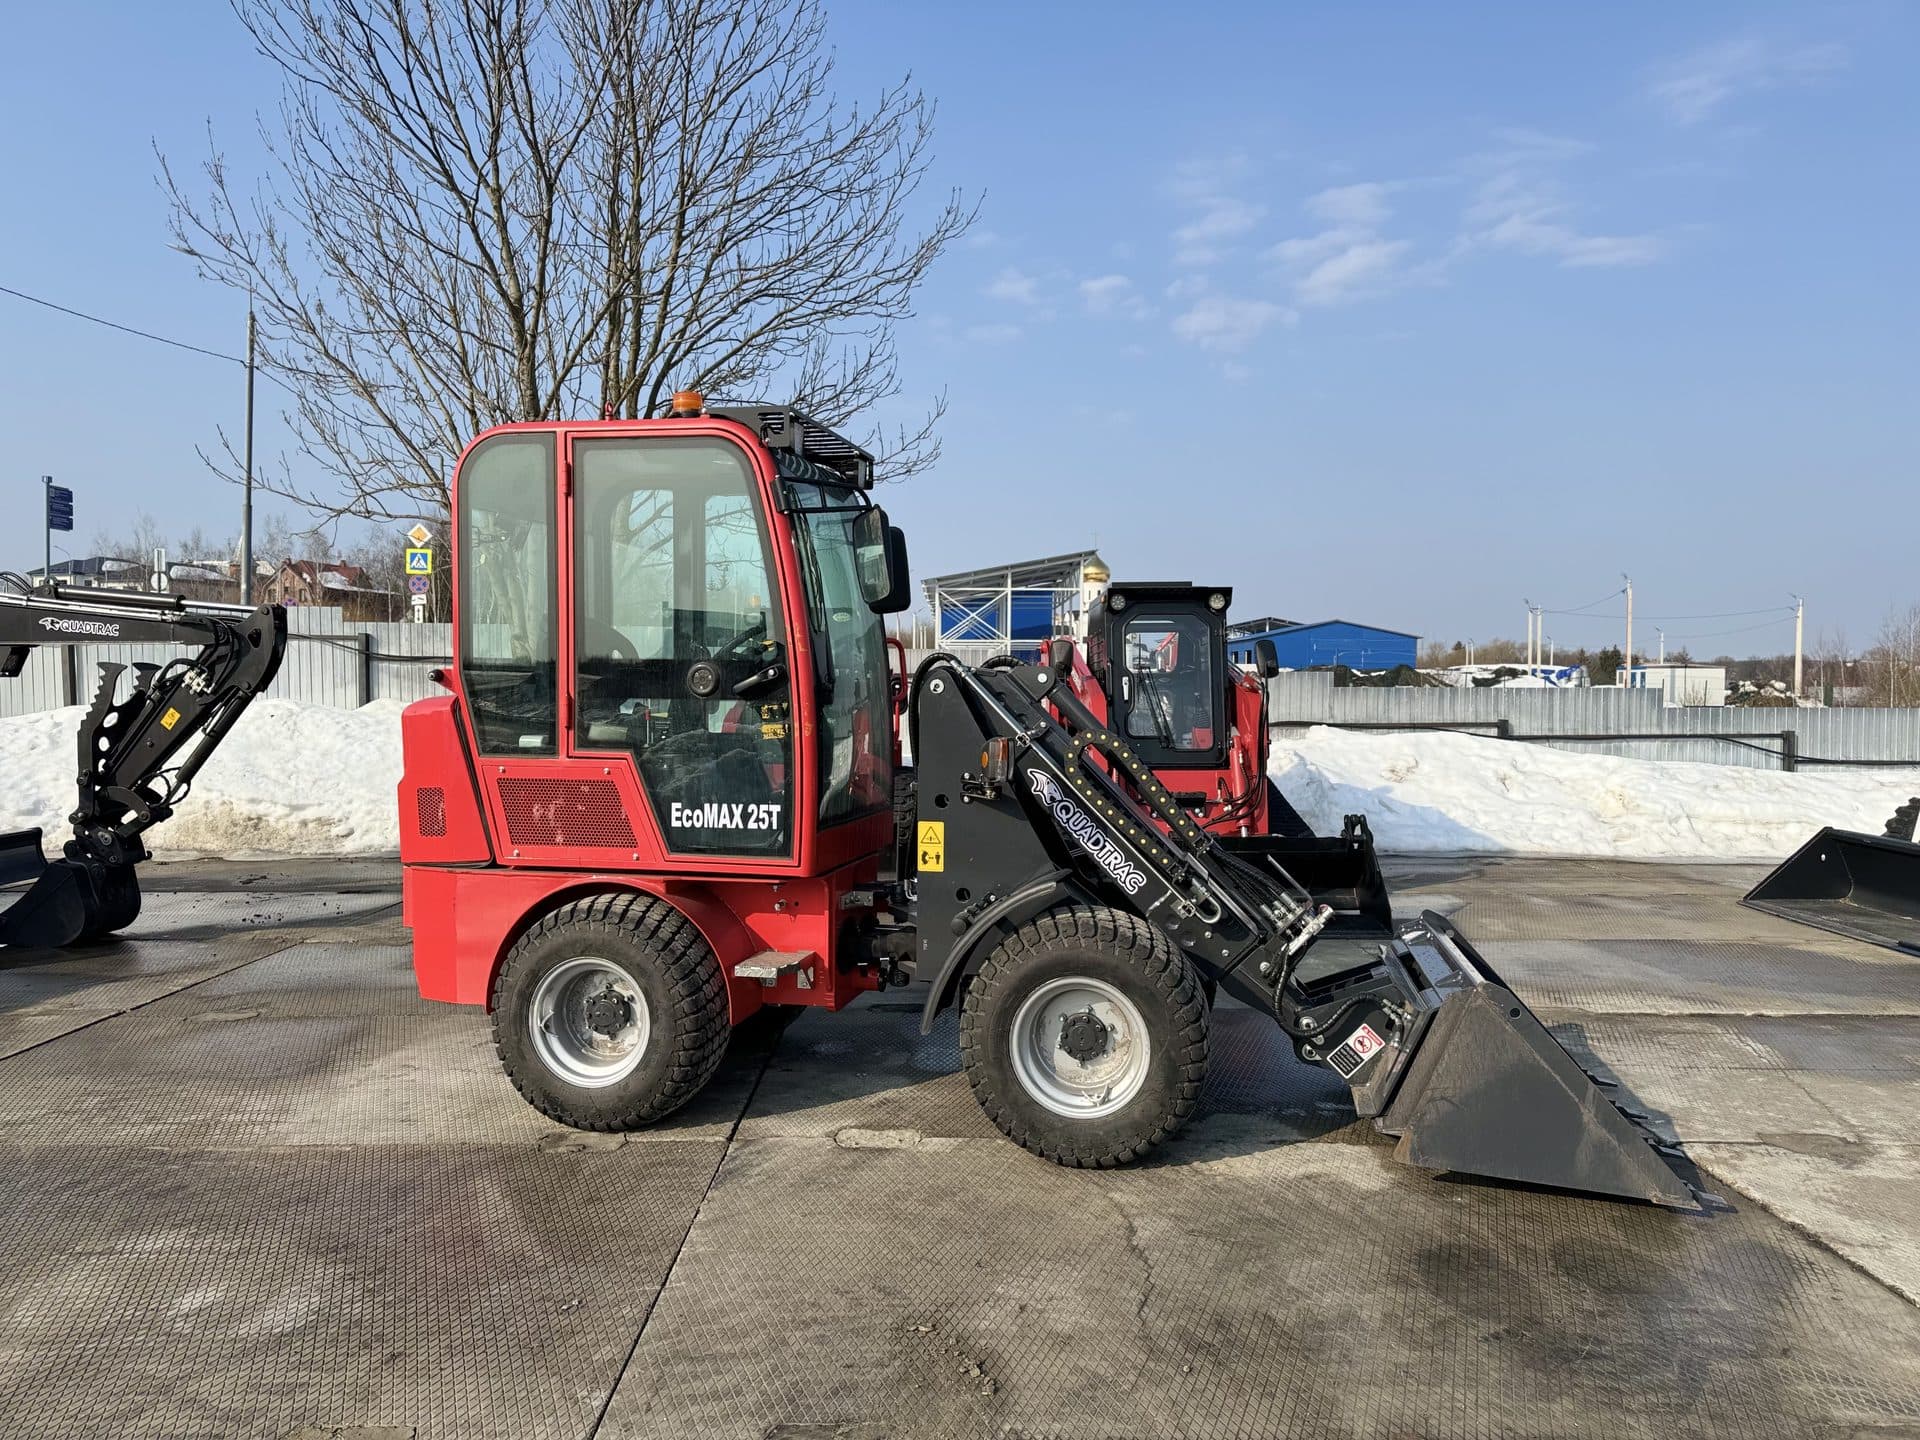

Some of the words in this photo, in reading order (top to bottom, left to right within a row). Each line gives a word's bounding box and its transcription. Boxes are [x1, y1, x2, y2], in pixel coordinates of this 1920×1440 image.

[60, 619, 119, 636] QUADTRAC
[671, 802, 744, 829] EcoMAX
[747, 803, 781, 830] 25T
[1054, 798, 1147, 894] QUADTRAC
